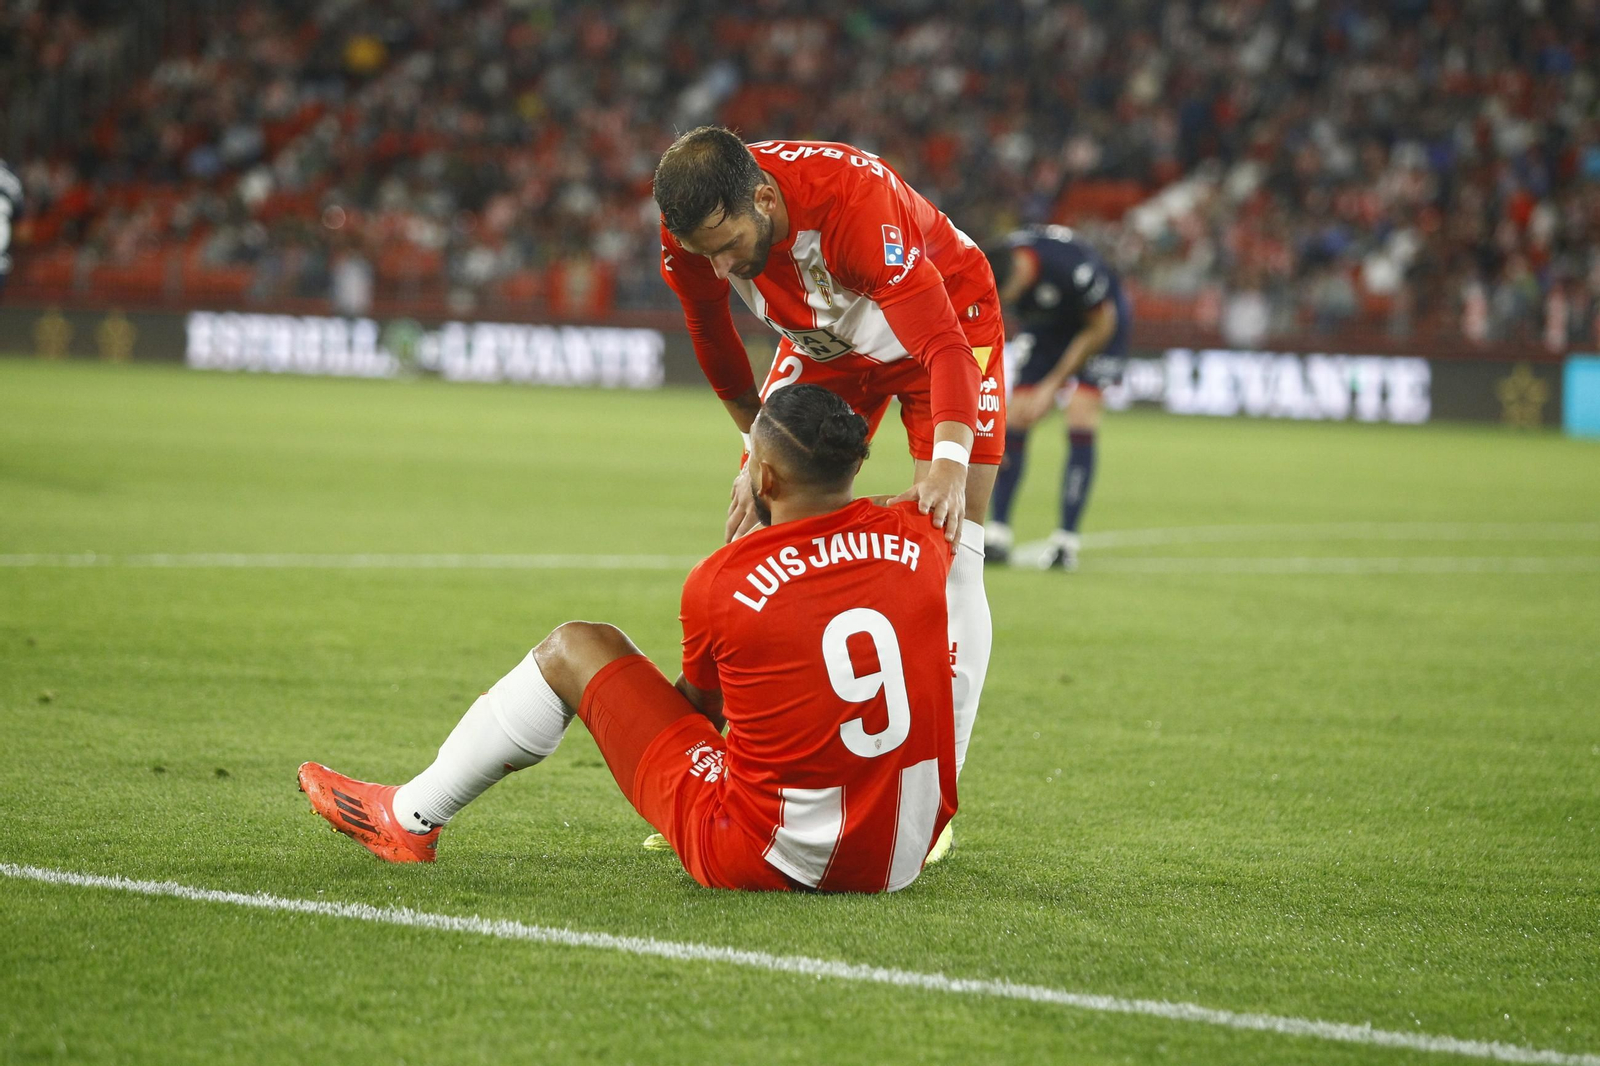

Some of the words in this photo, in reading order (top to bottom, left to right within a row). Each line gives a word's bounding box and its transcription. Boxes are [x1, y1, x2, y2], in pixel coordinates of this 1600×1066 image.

[978, 394, 1000, 412] UDU
[733, 546, 807, 613] LUIS
[808, 531, 921, 572] JAVIER
[821, 607, 911, 758] 9
